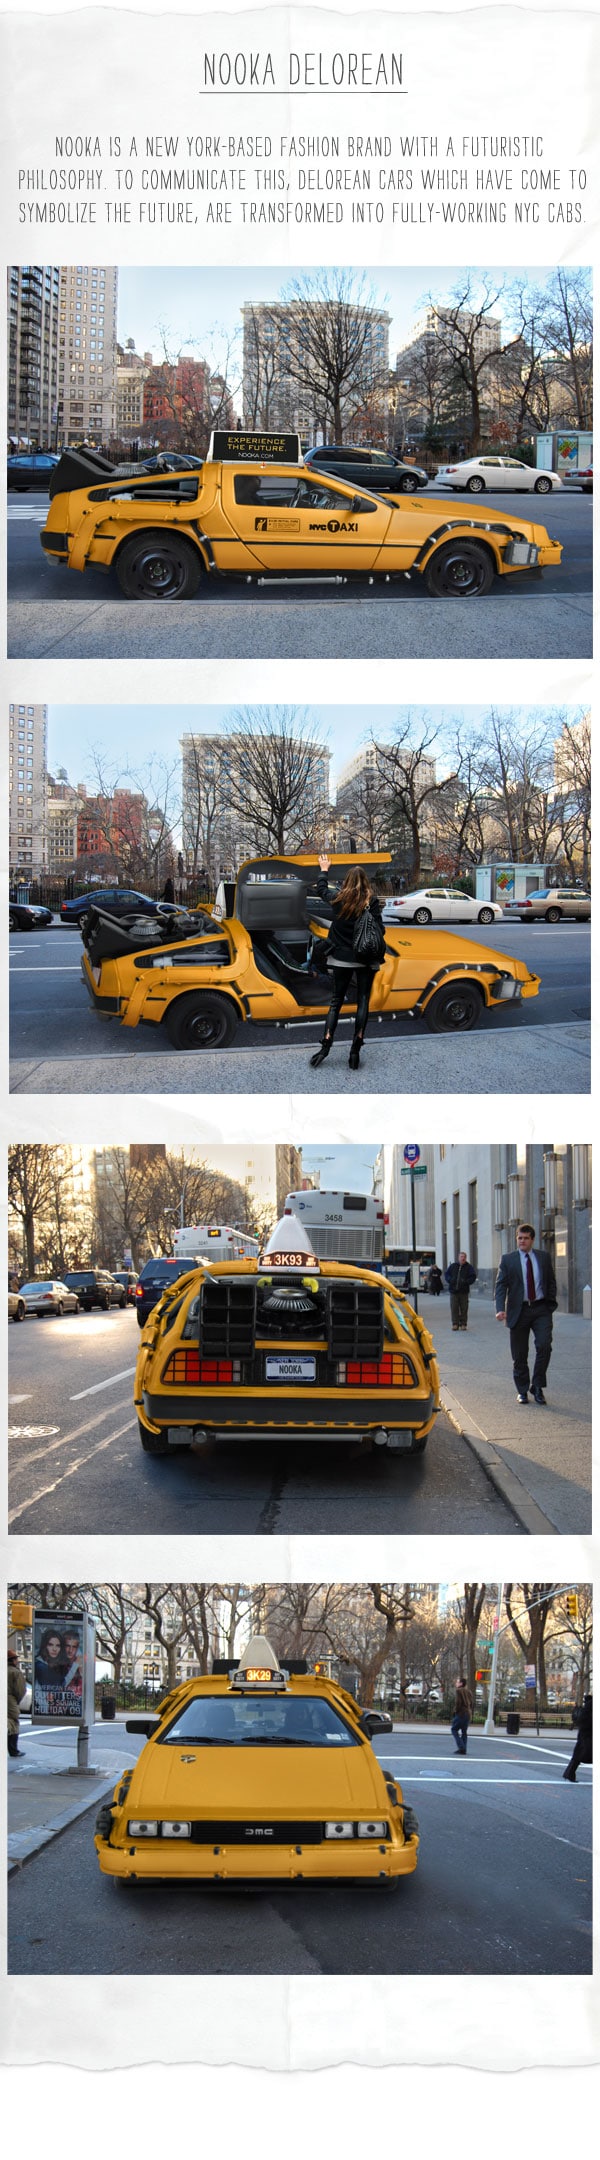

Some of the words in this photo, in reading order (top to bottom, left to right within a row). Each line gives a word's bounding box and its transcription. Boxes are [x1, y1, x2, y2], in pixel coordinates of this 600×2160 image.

[227, 436, 286, 445] EXPERIENCE
[227, 443, 246, 451] THE
[248, 444, 287, 452] FUTURE.
[308, 523, 327, 531] NYC
[327, 519, 359, 533] TAXI
[324, 1214, 343, 1222] 3458
[275, 1254, 303, 1266] 3K93
[278, 1364, 303, 1375] NOOKA
[246, 1669, 272, 1681] 3K29
[69, 1706, 81, 1715] 09
